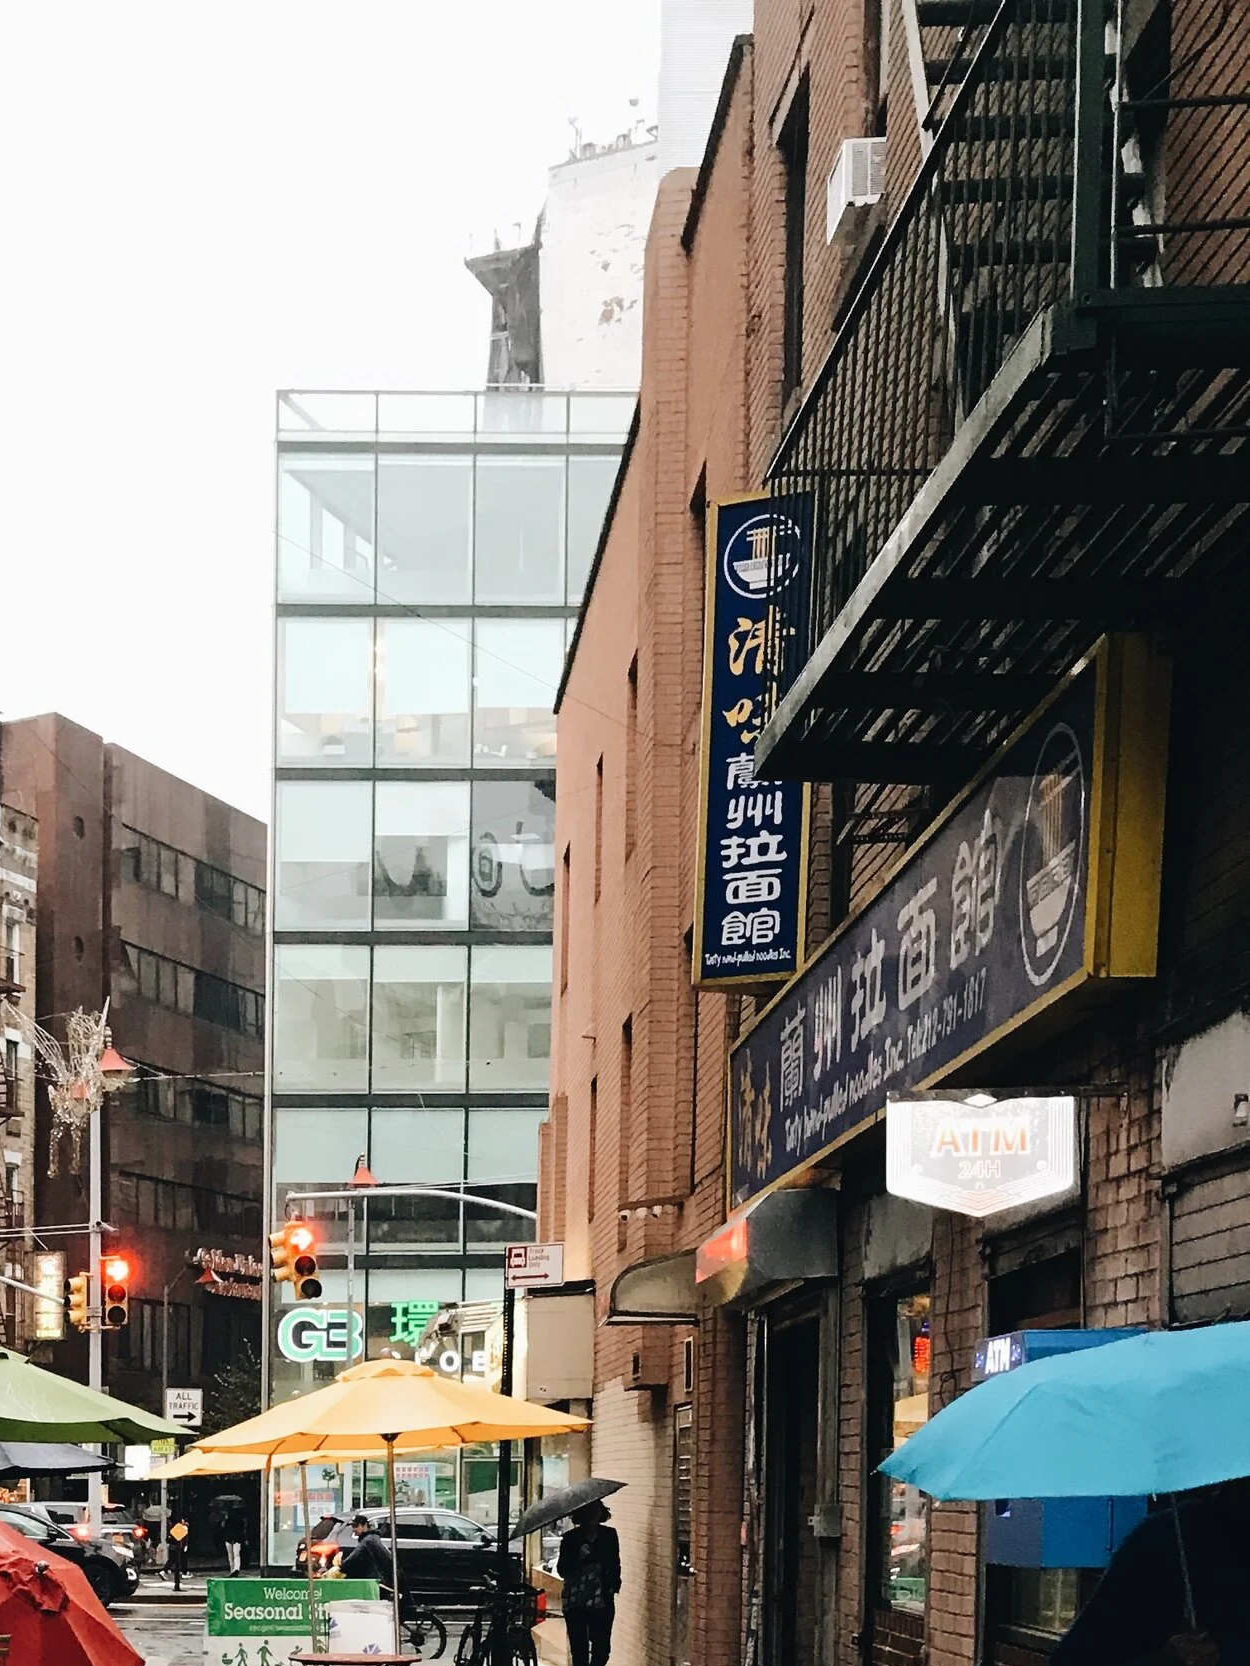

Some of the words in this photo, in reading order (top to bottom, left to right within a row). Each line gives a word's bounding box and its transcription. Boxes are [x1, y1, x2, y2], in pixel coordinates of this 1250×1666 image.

[849, 1050, 882, 1107] noodles
[934, 1118, 1030, 1156] ATM
[958, 1160, 1000, 1179] 24H
[984, 1337, 1011, 1375] ATM
[170, 1402, 199, 1410] TRAFFIC
[263, 1586, 323, 1600] Welcome!
[224, 1603, 304, 1620] Seasonal
